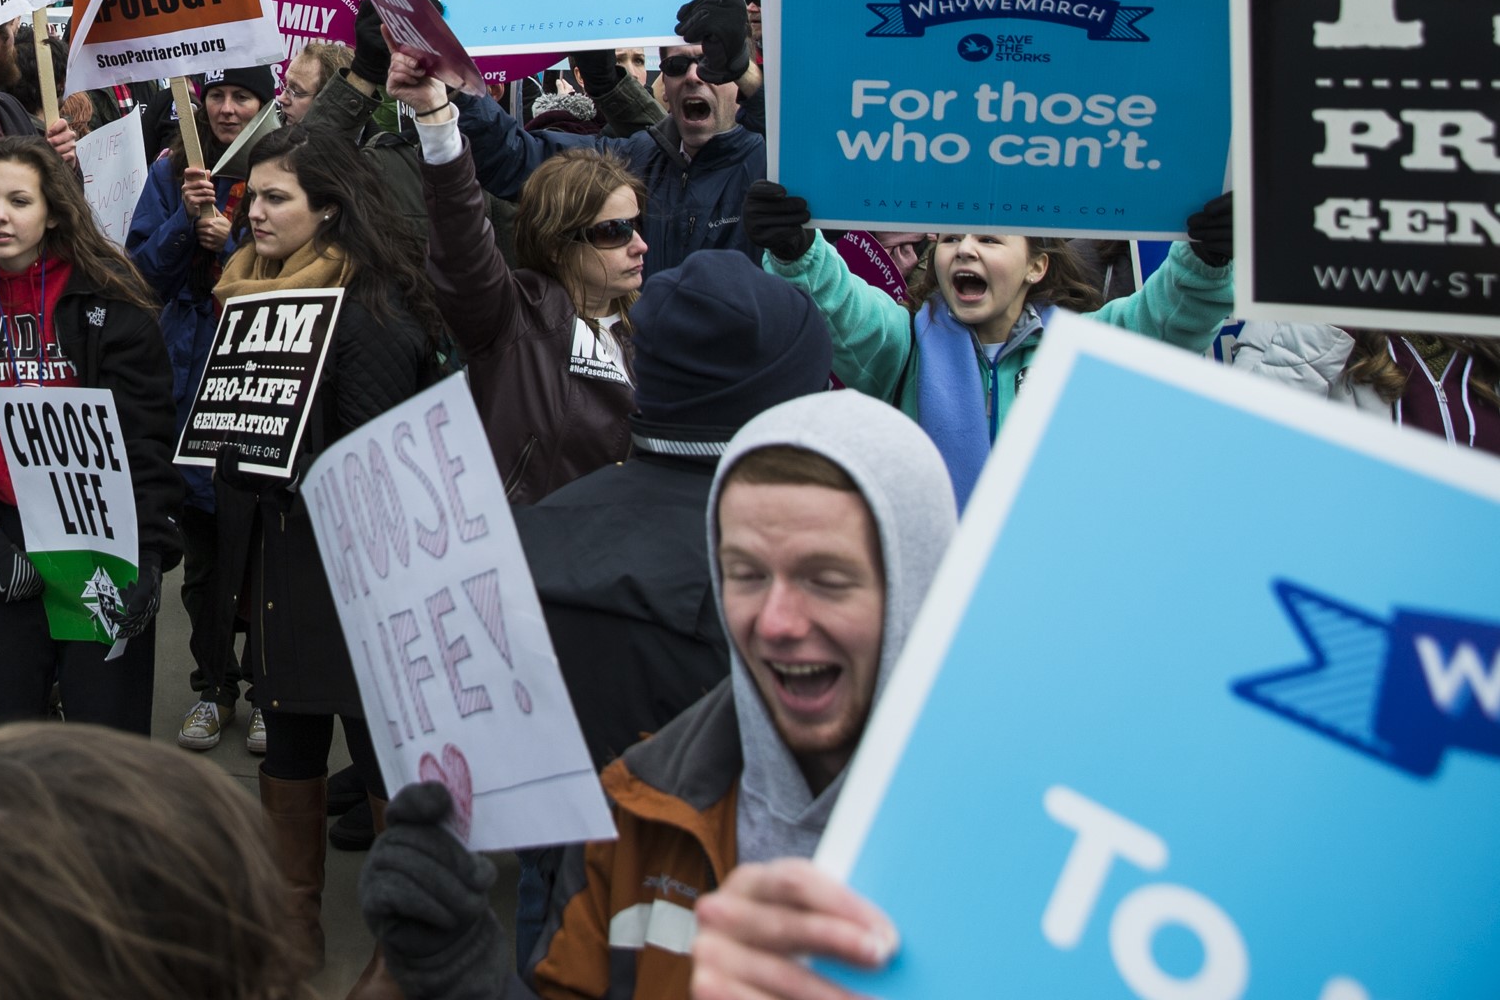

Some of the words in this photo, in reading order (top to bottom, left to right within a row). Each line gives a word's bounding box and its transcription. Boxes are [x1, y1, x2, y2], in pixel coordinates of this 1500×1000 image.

[483, 16, 645, 33] SAVETHESTORKS.COM
[96, 36, 227, 70] StopPatriarchy.org
[996, 35, 1033, 45] SAVE
[996, 44, 1023, 53] THE
[995, 53, 1051, 63] STORKS
[851, 79, 957, 121] For
[974, 80, 1157, 127] those
[836, 121, 971, 164] who
[860, 238, 896, 286] Majority
[86, 311, 106, 321] NORTH
[89, 318, 104, 327] FACE
[94, 306, 107, 315] THE
[216, 310, 244, 355] I
[237, 304, 323, 354] AM
[245, 360, 257, 371] the
[201, 376, 302, 406] PRO-LIFE
[3, 401, 123, 473] CHOOSE
[193, 412, 289, 436] GENERATION
[51, 471, 116, 540] LIFE
[94, 581, 102, 592] K
[109, 585, 115, 596] C
[362, 567, 532, 749] LIFE!
[1043, 785, 1250, 1000] To
